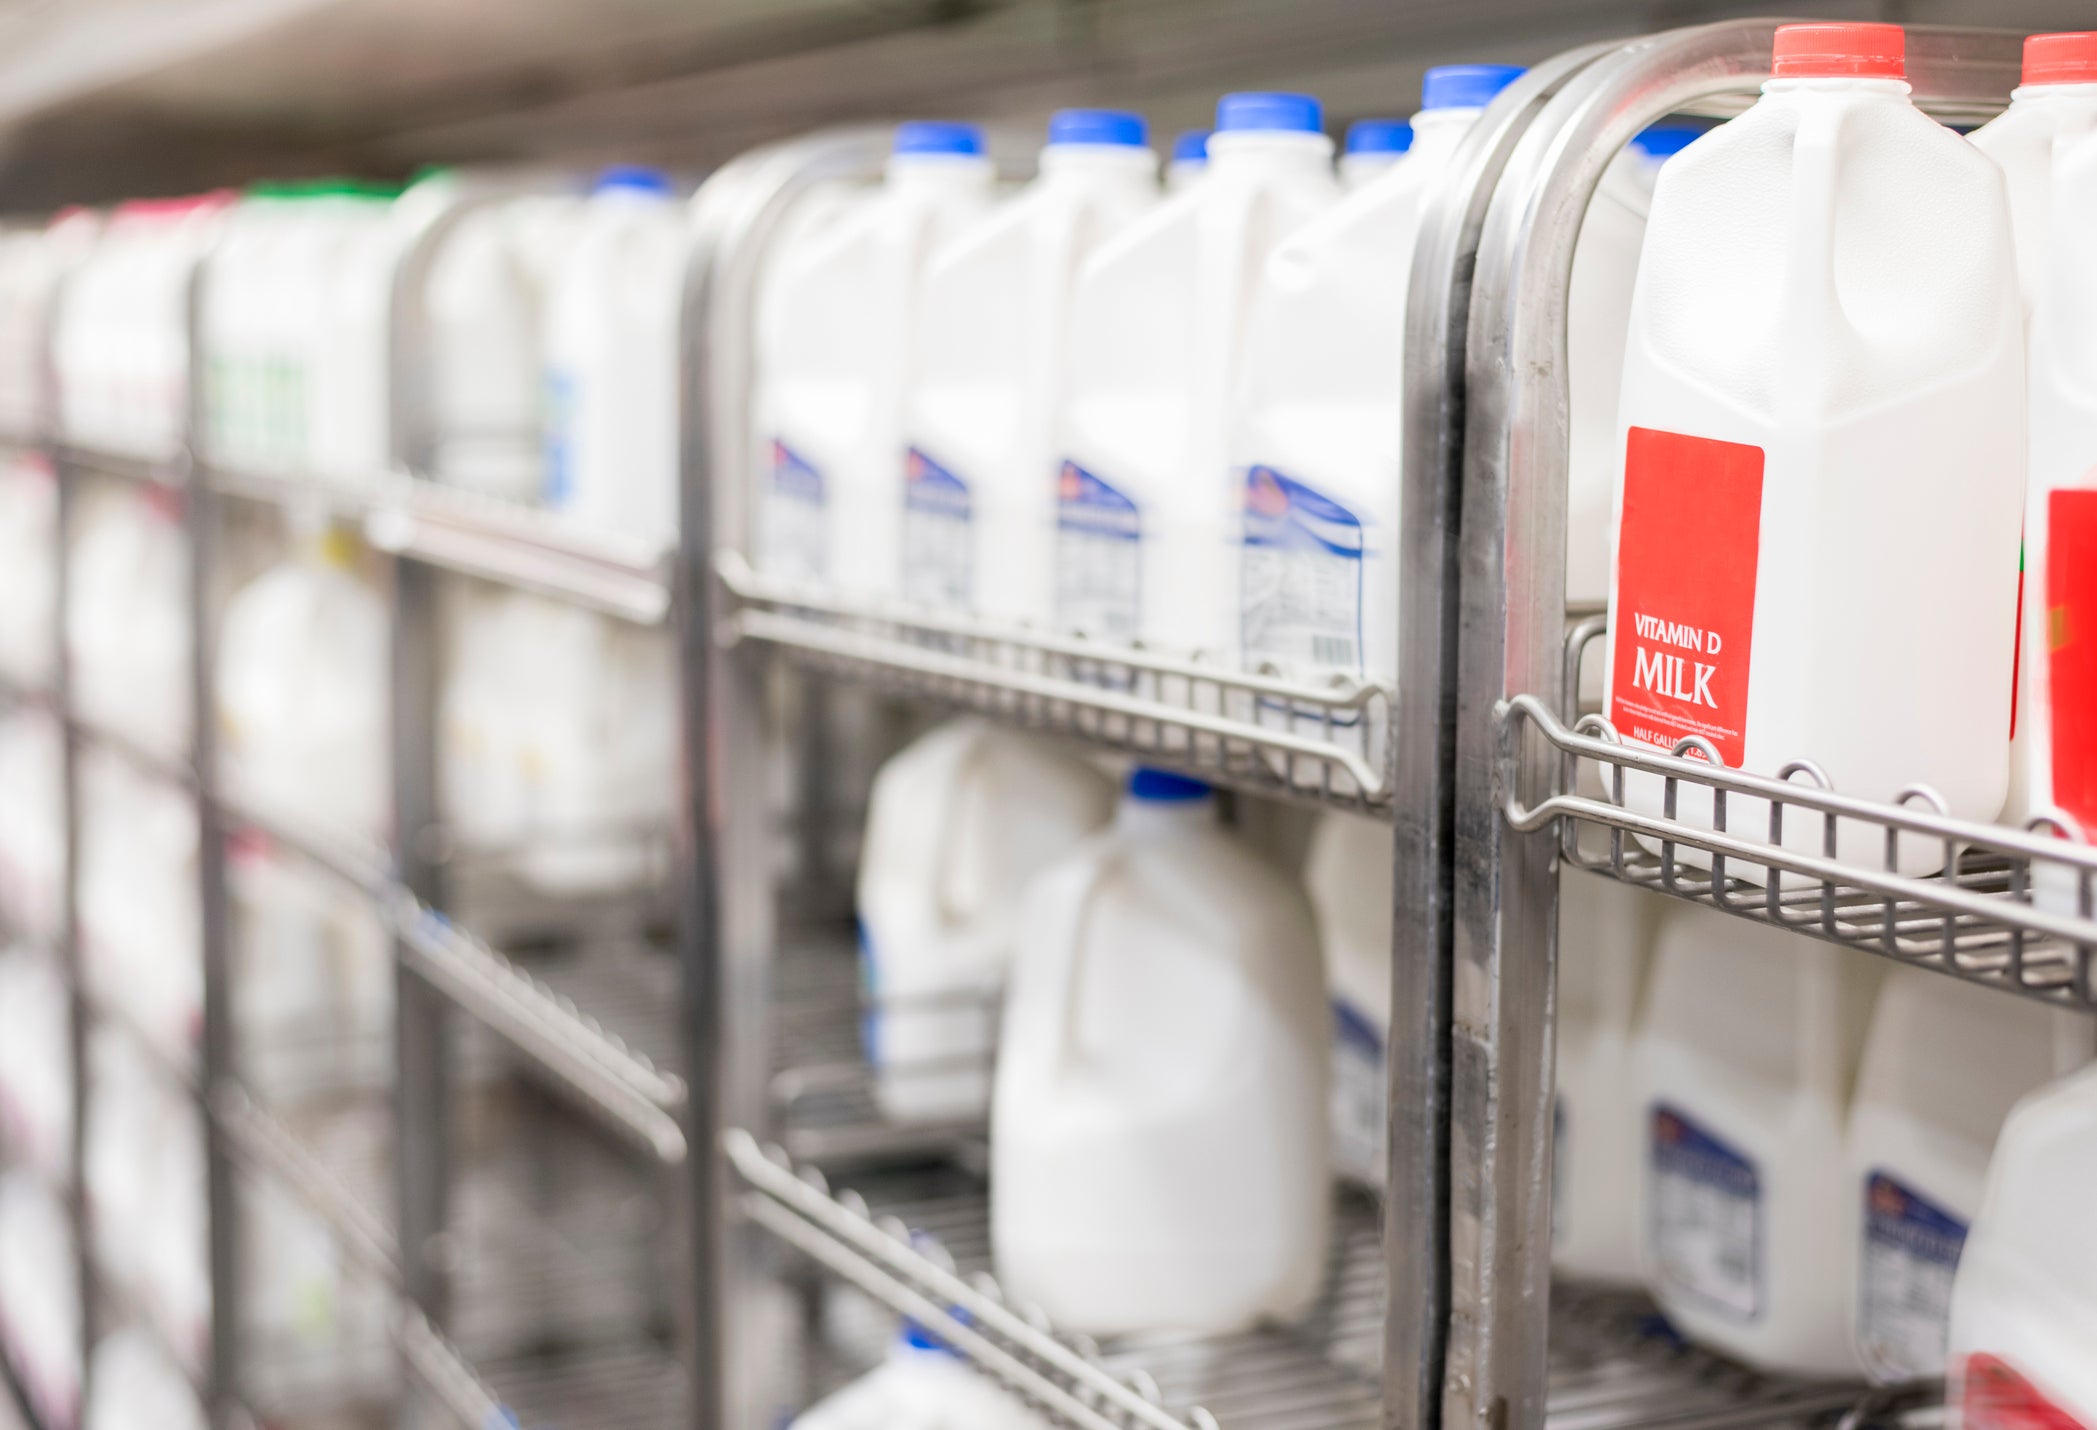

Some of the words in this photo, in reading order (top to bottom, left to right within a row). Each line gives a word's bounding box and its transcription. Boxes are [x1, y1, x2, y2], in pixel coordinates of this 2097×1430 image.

[1634, 612, 1703, 652] VITAMIN
[1706, 631, 1722, 655] D
[1632, 646, 1718, 709] MILK
[1633, 725, 1653, 742] HALF
[1653, 732, 1679, 748] GALLO
